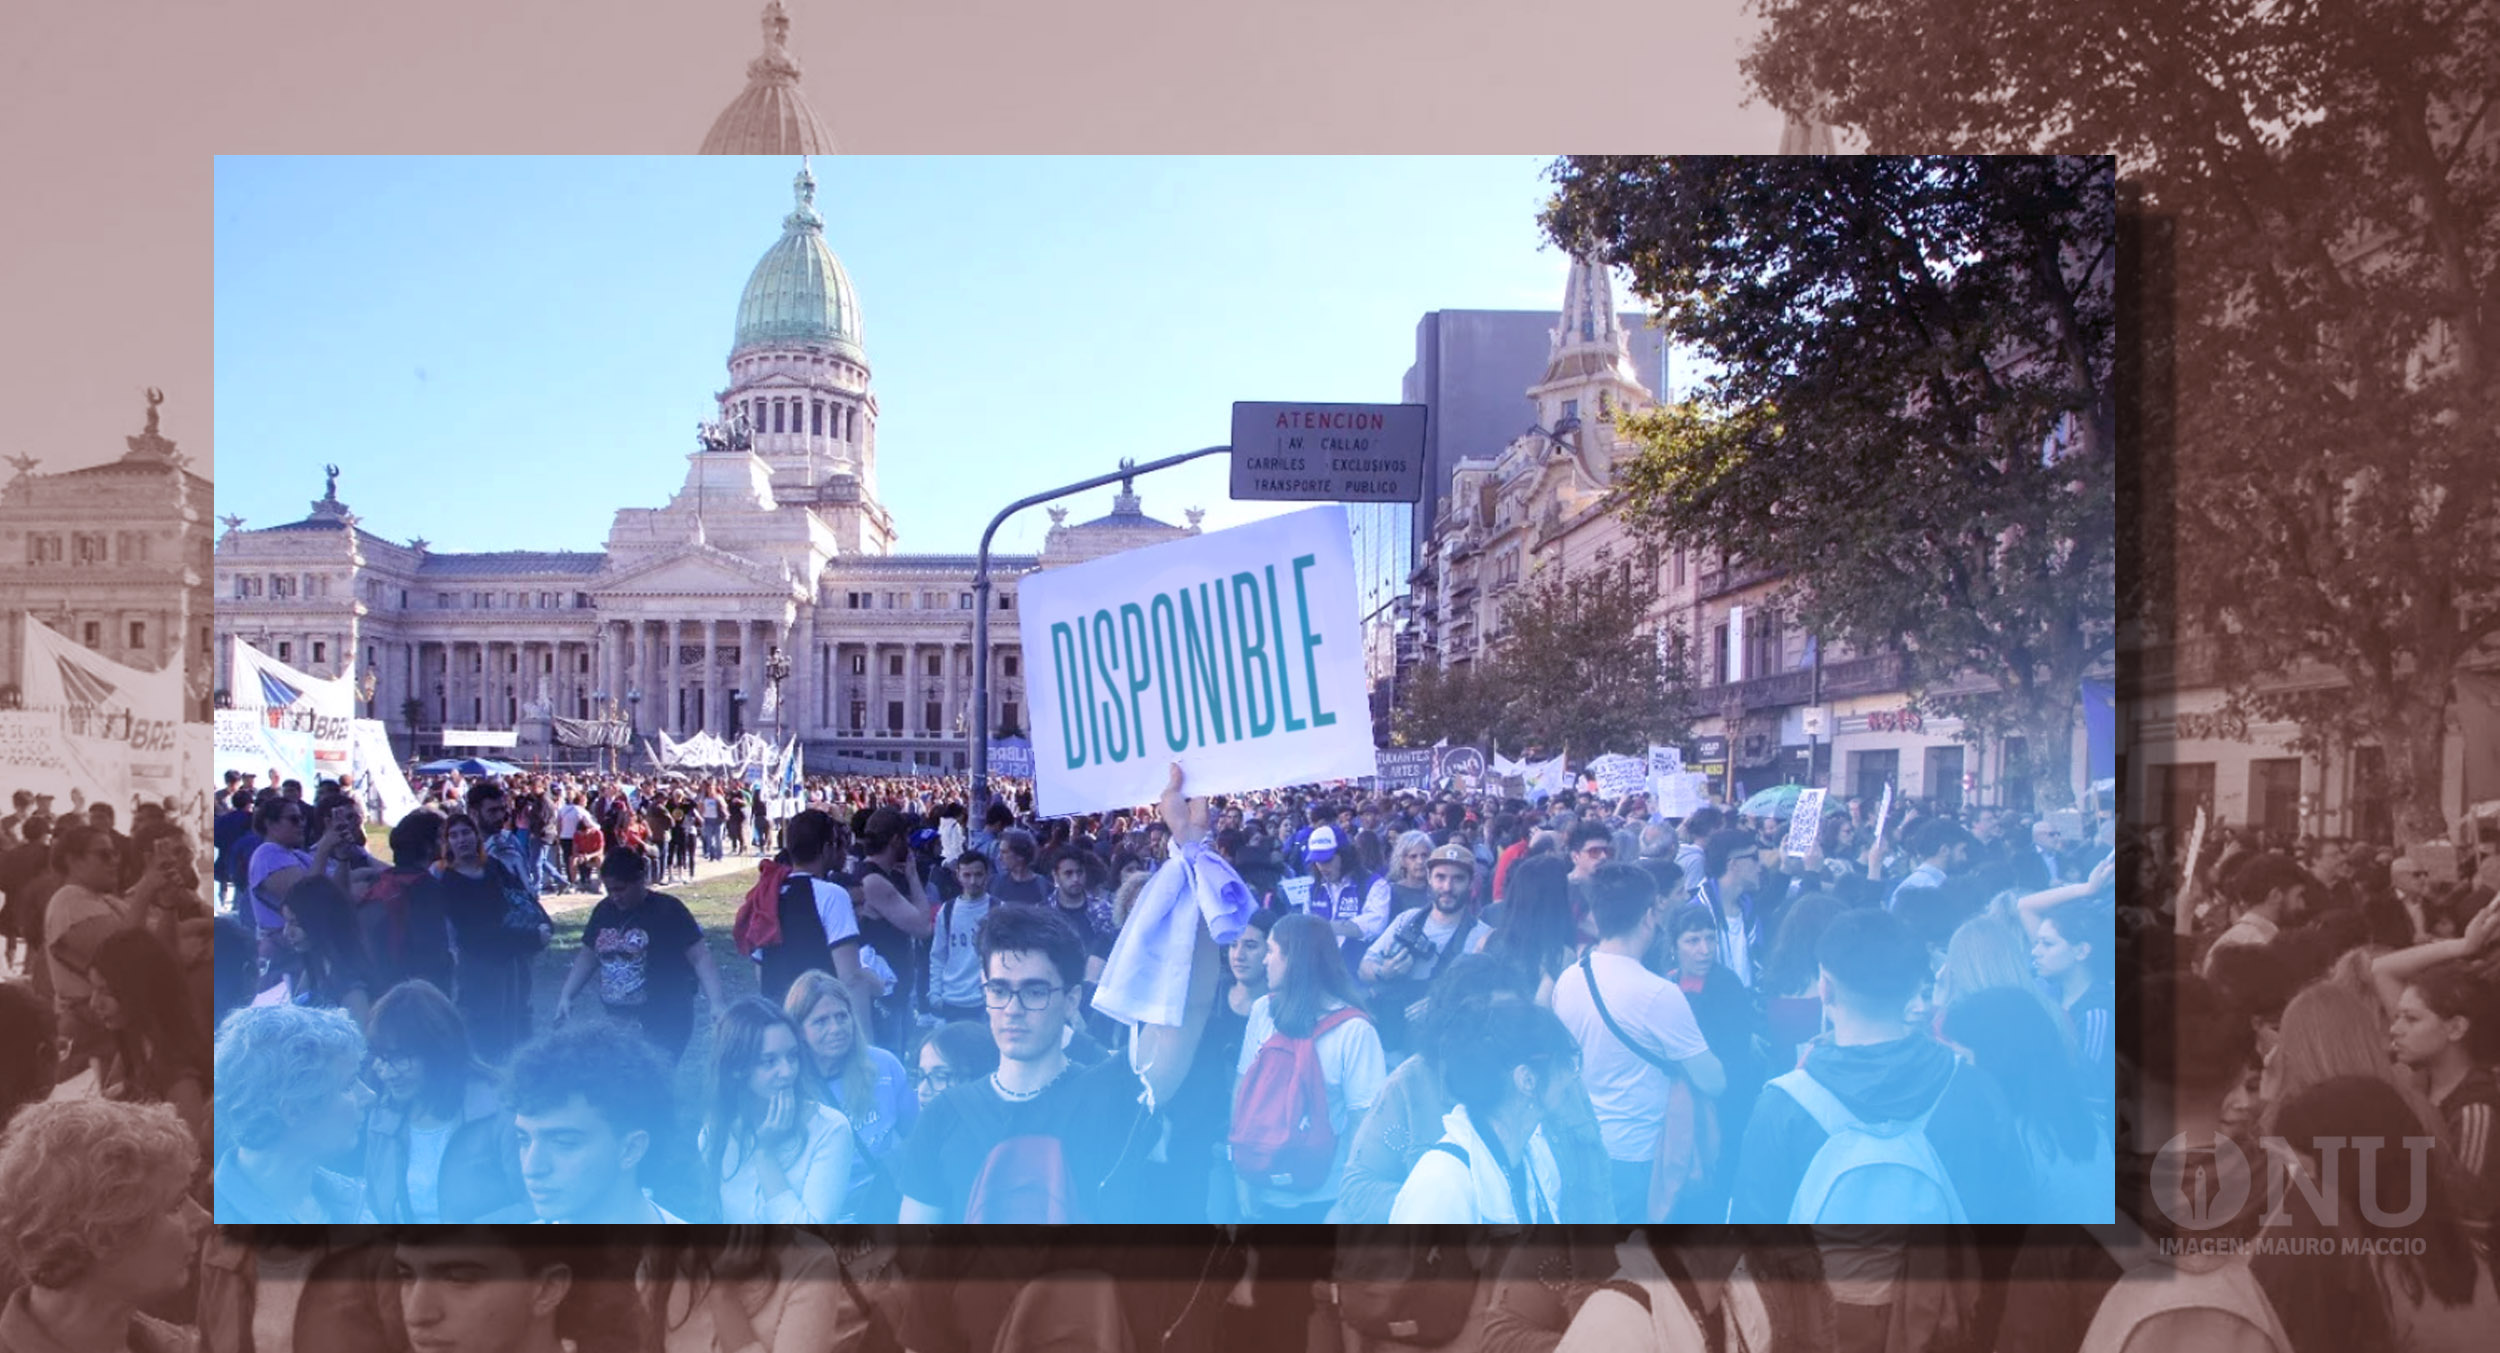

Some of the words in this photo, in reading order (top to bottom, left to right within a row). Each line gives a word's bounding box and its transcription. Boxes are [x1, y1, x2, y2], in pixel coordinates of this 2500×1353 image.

[1276, 412, 1384, 430] ATENCION
[1320, 437, 1369, 451] CALLAO
[1247, 457, 1306, 471] CARRILES
[1332, 458, 1407, 473] EXCLUSIVOS
[1254, 479, 1332, 493] TRANSPORTE
[1345, 480, 1398, 494] PUBLICO
[1051, 553, 1337, 770] DISPONIBLE
